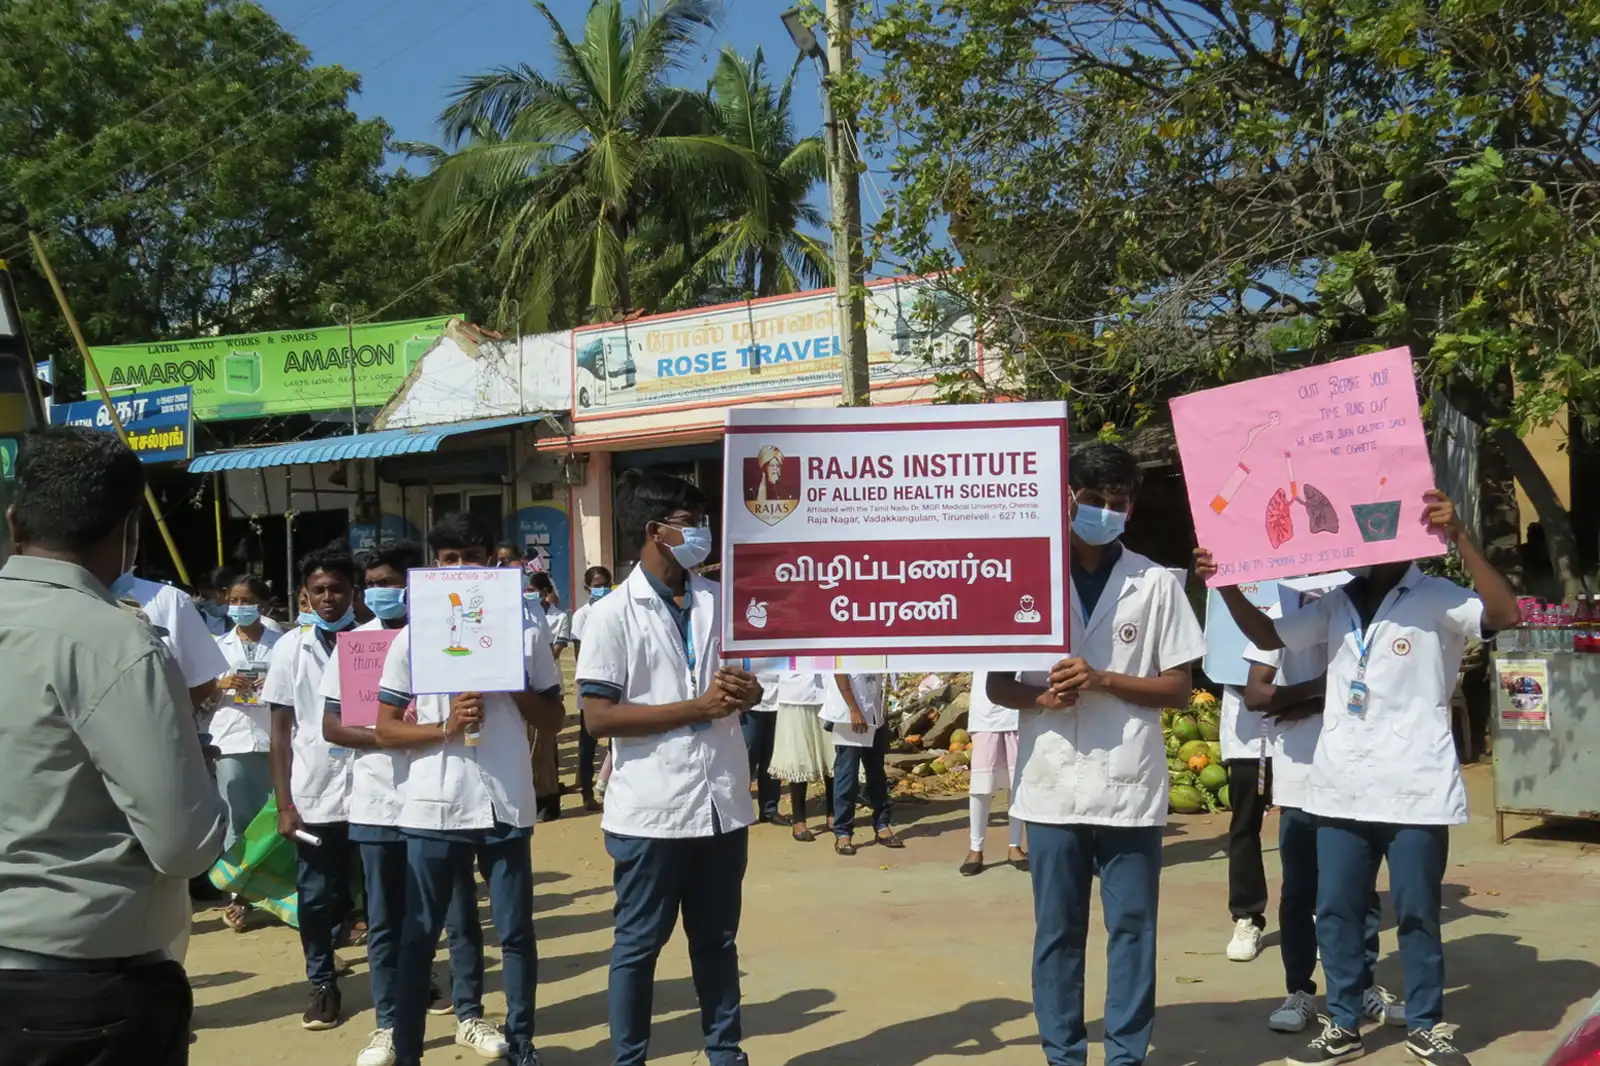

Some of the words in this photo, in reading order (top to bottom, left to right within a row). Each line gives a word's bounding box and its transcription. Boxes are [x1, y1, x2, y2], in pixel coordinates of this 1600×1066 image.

[731, 301, 839, 345] டிராவல்
[147, 343, 180, 355] LATHA
[189, 340, 215, 351] AUTO
[225, 336, 261, 348] WORKS
[267, 335, 275, 344] &
[280, 332, 318, 344] SPARES
[657, 350, 727, 378] ROSE
[736, 335, 841, 368] TRAVEL
[109, 357, 216, 386] AMARON
[283, 343, 395, 374] AMARON
[1298, 382, 1319, 400] QUIT
[1328, 375, 1361, 400] BEFORE
[1369, 368, 1389, 388] YOUR
[1320, 406, 1341, 421] TIME
[1344, 402, 1365, 417] RUNS
[1370, 398, 1388, 414] OUT
[128, 426, 184, 451] ன்சல்டிங்
[1309, 432, 1324, 443] NEED
[1325, 430, 1333, 440] TO
[807, 454, 894, 480] RAJAS
[903, 451, 1038, 478] INSTITUTE
[807, 487, 828, 502] OF
[832, 486, 888, 502] ALLIED
[893, 484, 954, 500] HEALTH
[959, 482, 1039, 499] SCIENCES
[754, 503, 790, 515] RAJAS
[806, 505, 839, 514] Affiliated
[840, 504, 855, 513] with
[856, 503, 868, 512] the
[870, 503, 889, 512] Tamil
[890, 503, 910, 512] Nadu
[922, 502, 940, 511] MGR
[942, 502, 970, 511] Medical
[971, 501, 1008, 511] University,
[806, 515, 828, 527] Raja
[830, 515, 861, 526] Nagar,
[863, 512, 940, 524] Vadakkangulam,
[942, 511, 990, 521] Tirunelveli
[999, 511, 1016, 521] 627
[1020, 511, 1040, 520] 116.
[775, 552, 1013, 590] விழிப்புணர்வு
[1219, 561, 1235, 577] SAY
[1238, 560, 1250, 573] NO
[1251, 558, 1264, 571] TO
[1299, 552, 1312, 565] SAY
[1317, 549, 1329, 562] YES
[1332, 548, 1341, 560] TO
[1342, 546, 1355, 559] LIFE
[829, 593, 958, 627] பேரணி
[353, 655, 381, 671] think
